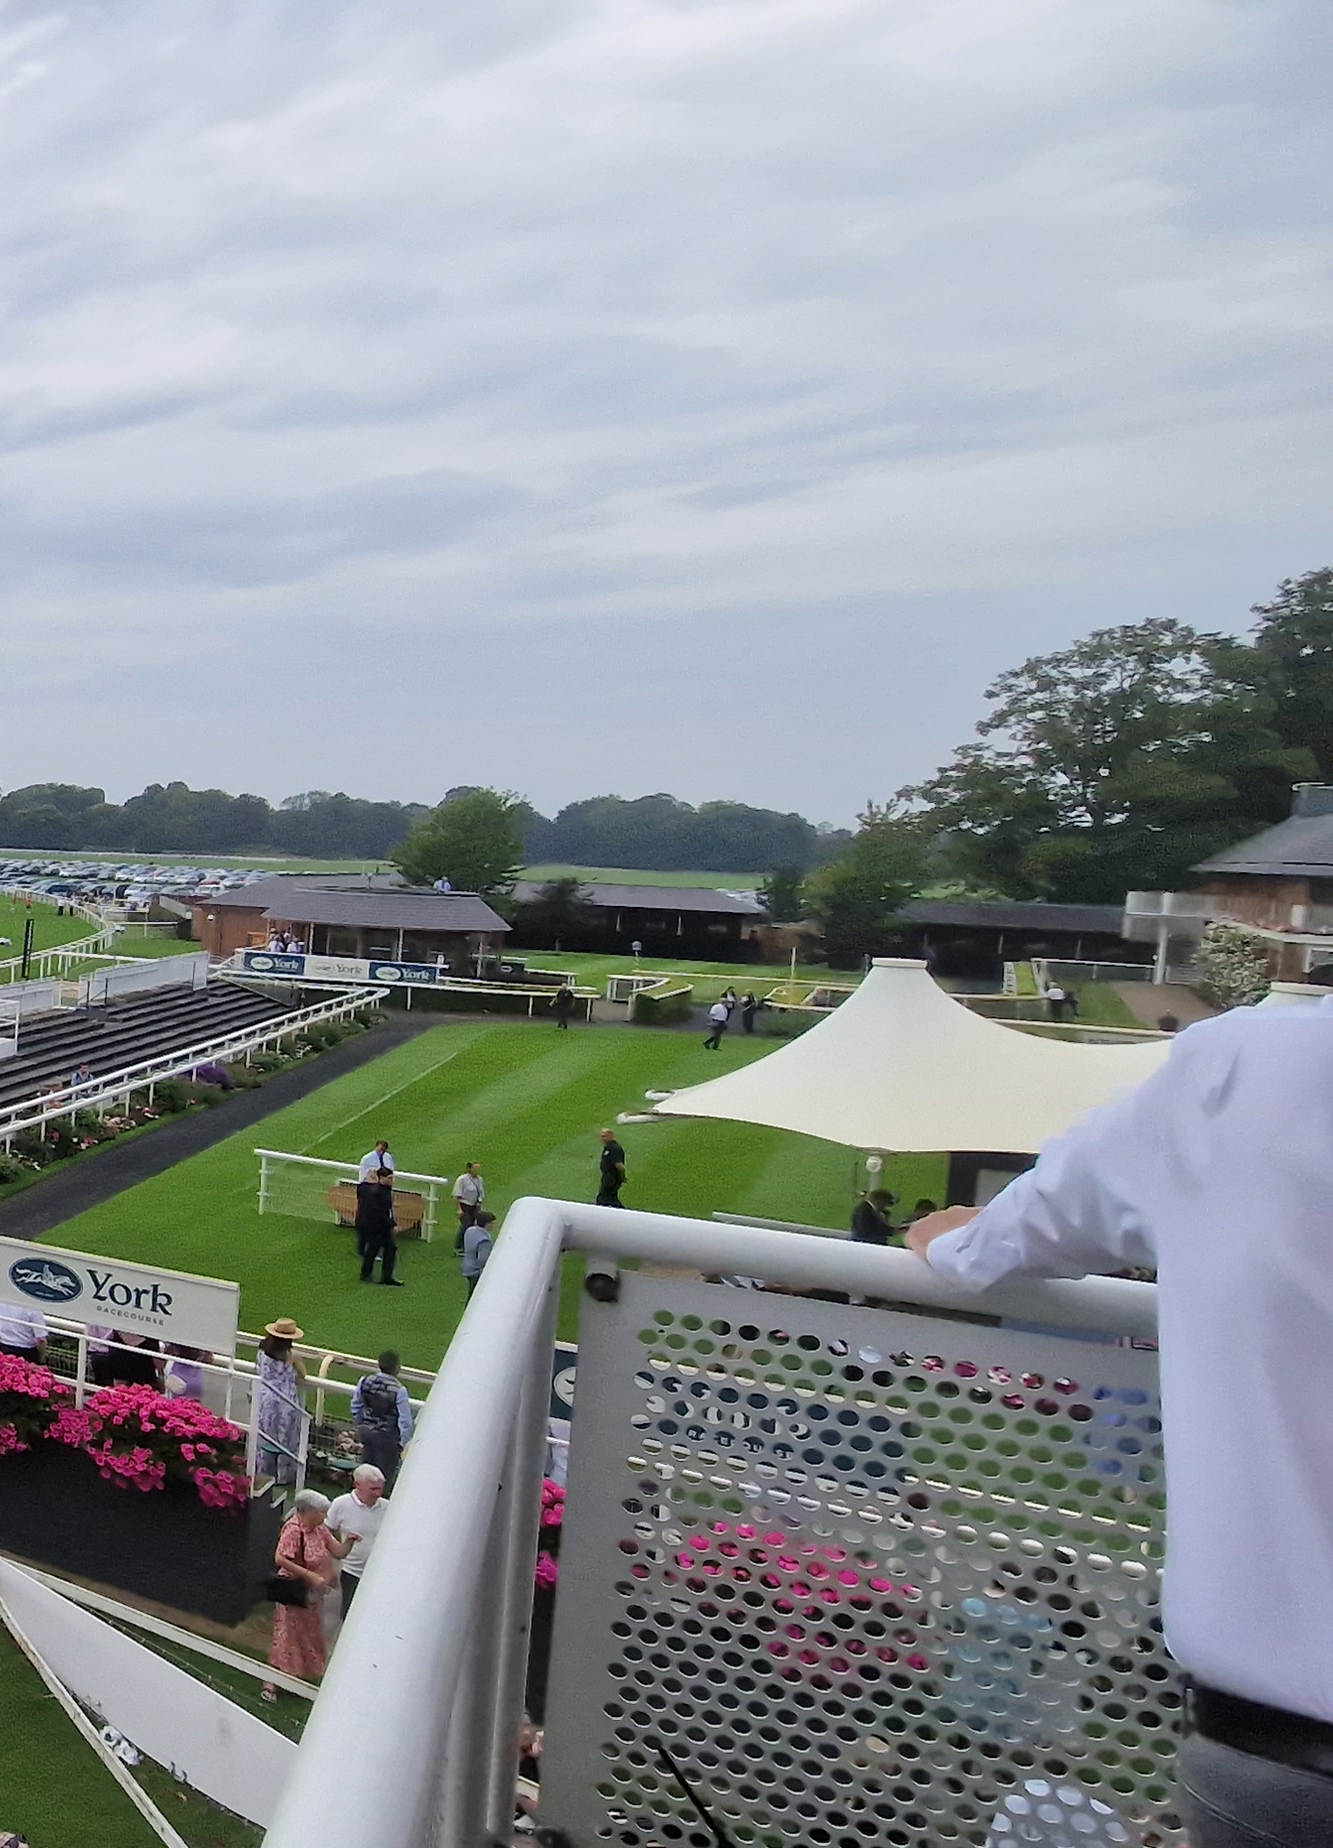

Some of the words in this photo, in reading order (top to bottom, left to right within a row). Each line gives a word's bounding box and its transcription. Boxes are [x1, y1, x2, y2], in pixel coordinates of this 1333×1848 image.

[273, 957, 299, 969] York
[336, 964, 363, 975] York
[402, 967, 430, 980] York
[85, 1268, 173, 1316] York
[96, 1304, 165, 1326] RACECOURSE
